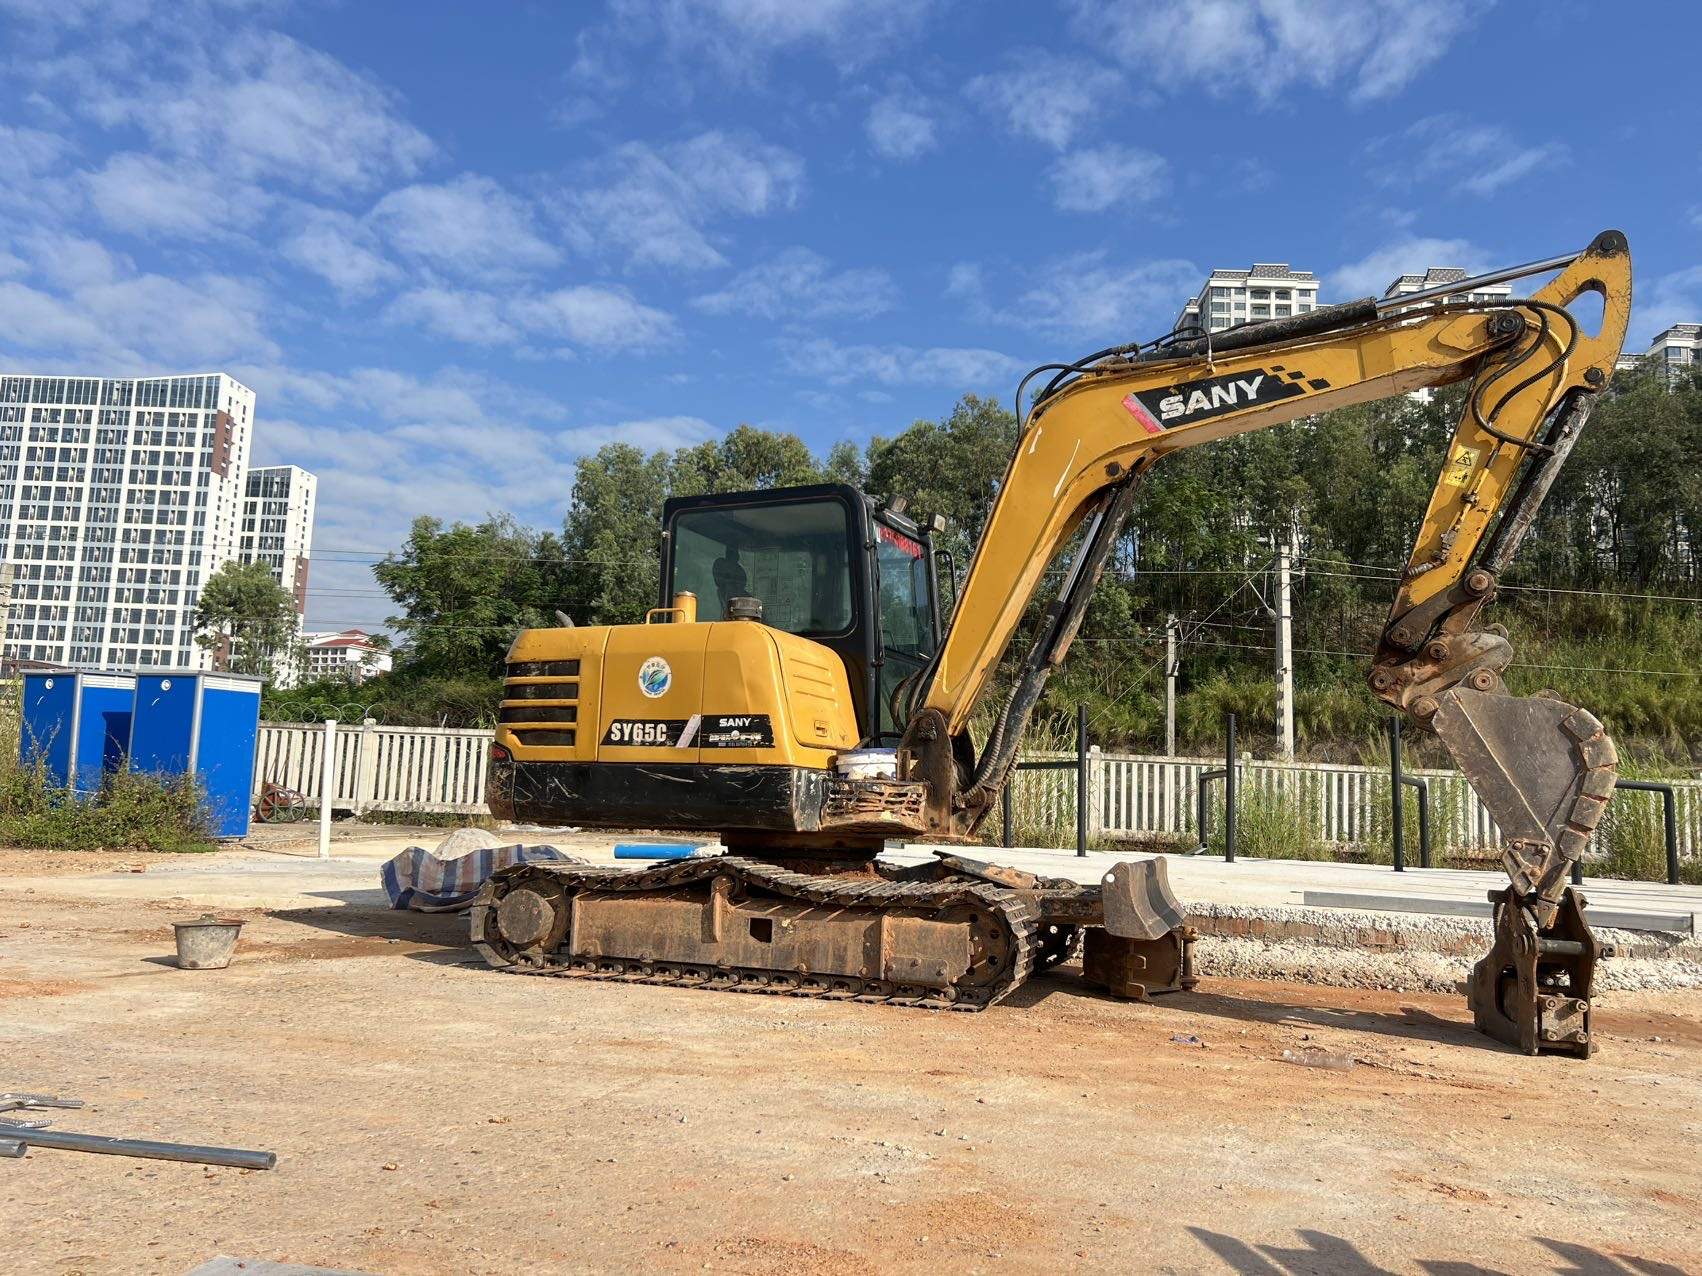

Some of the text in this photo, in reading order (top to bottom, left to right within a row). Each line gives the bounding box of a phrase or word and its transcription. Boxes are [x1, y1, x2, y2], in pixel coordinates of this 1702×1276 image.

[1159, 375, 1264, 420] SANY
[610, 722, 667, 741] SY65C
[719, 717, 752, 727] SANY
